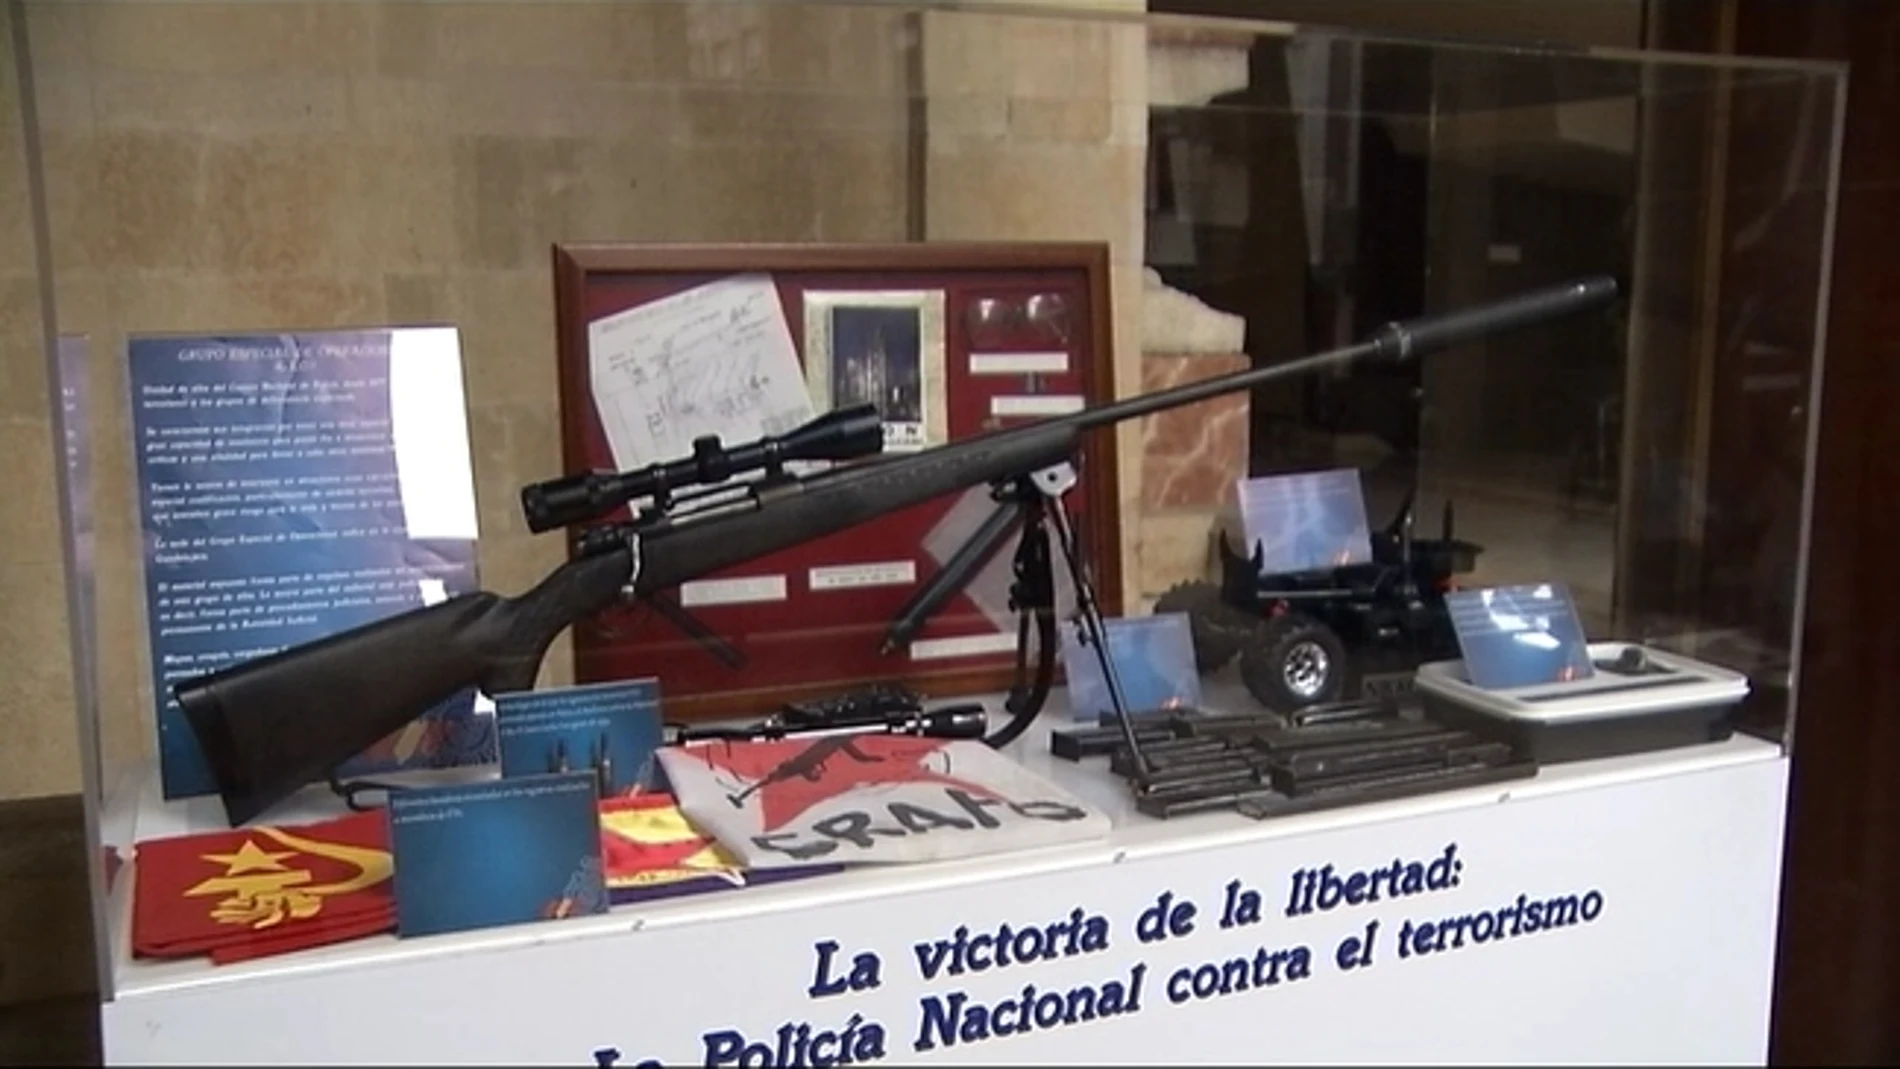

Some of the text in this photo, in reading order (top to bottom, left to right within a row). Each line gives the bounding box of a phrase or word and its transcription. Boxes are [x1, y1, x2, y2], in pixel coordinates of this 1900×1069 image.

[703, 889, 1603, 1067] Policía Nacional contra el terrorismo
[808, 843, 1463, 998] La victoria de la libertad:
